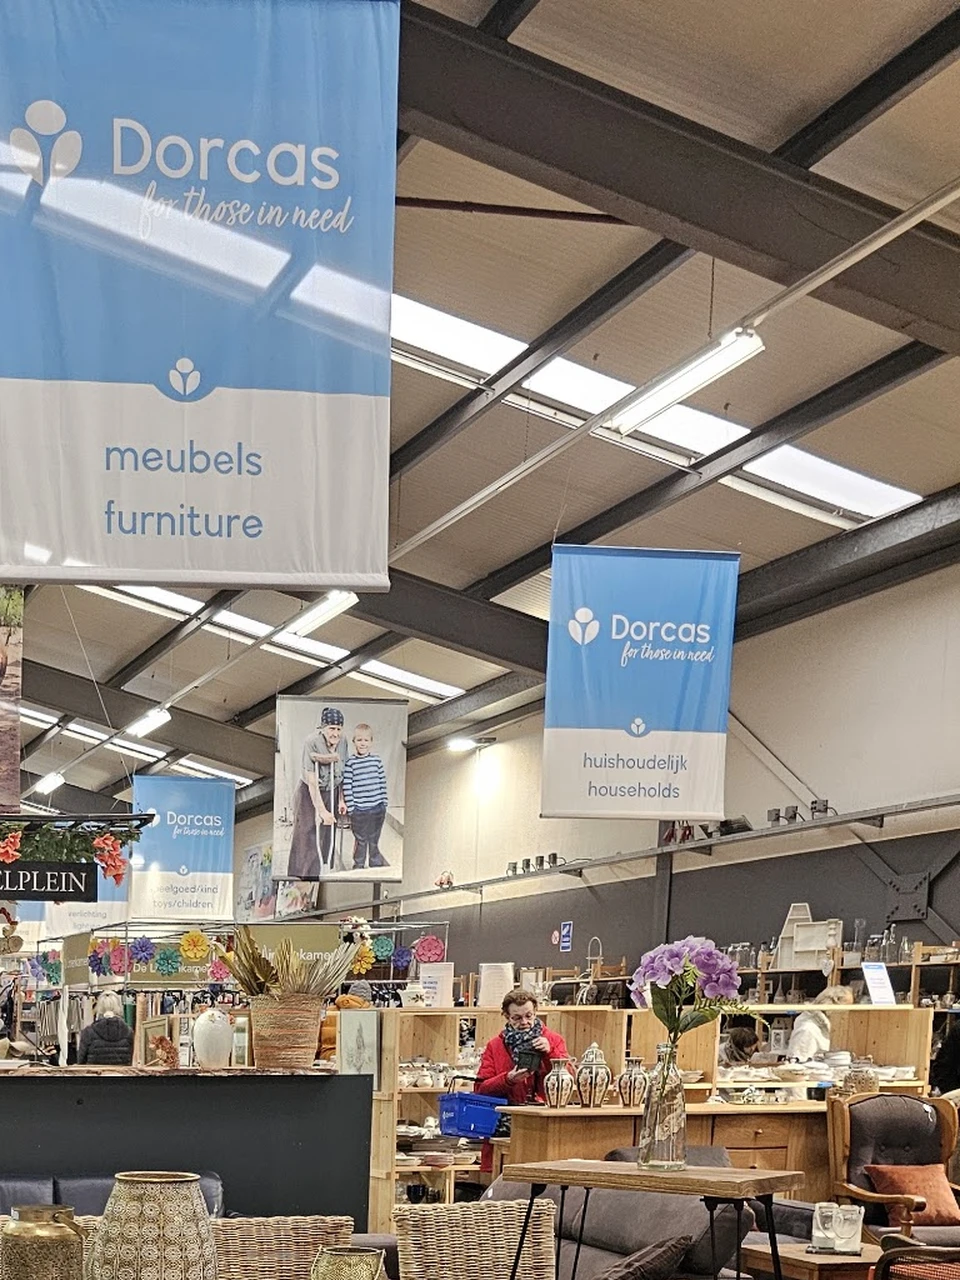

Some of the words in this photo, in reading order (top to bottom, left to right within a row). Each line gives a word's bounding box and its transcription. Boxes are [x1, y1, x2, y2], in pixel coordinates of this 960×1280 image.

[113, 118, 340, 190] Dorcas
[140, 180, 180, 239] for
[183, 186, 254, 225] those
[257, 201, 290, 227] in
[292, 196, 355, 233] need
[105, 439, 262, 476] meubels
[105, 500, 264, 539] furniture
[611, 614, 711, 643] Dorcas
[621, 641, 640, 667] for
[640, 642, 672, 661] those
[673, 647, 688, 661] in
[688, 646, 715, 662] need
[583, 752, 688, 774] huishoudelijk
[588, 781, 680, 799] households
[166, 811, 222, 826] Dorcas
[153, 899, 214, 910] toys/children
[133, 963, 147, 973] De
